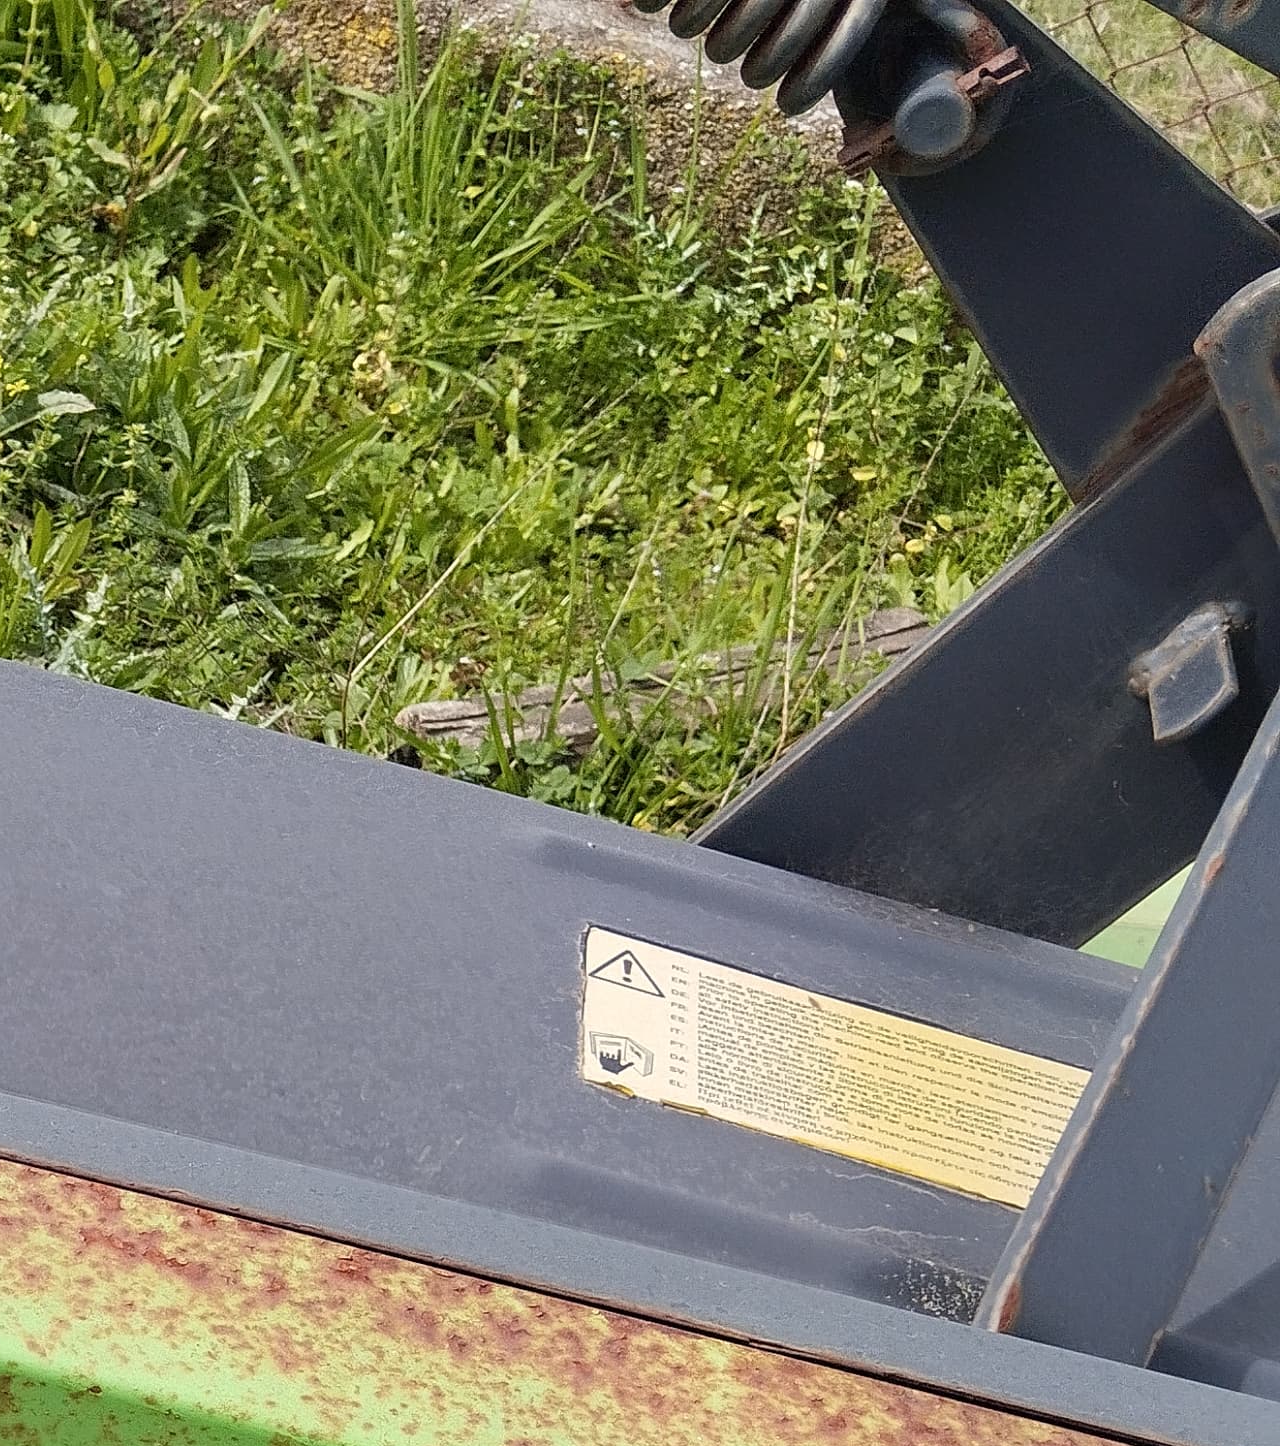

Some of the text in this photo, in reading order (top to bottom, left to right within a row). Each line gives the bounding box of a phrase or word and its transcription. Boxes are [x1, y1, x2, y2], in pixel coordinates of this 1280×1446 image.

[698, 977, 745, 997] machine
[750, 992, 760, 1001] in
[698, 990, 710, 999] all
[714, 994, 748, 1011] safety
[697, 1002, 728, 1017] lesen
[728, 980, 742, 990] de
[858, 1019, 872, 1028] en
[698, 983, 724, 997] Prior
[743, 996, 796, 1019] operating
[979, 1065, 998, 1077] the
[698, 996, 717, 1007] Vor
[813, 1030, 830, 1040] die
[939, 1066, 961, 1079] und
[966, 1074, 983, 1085] die
[768, 1035, 783, 1045] de
[697, 1034, 744, 1054] Leggere
[737, 1033, 751, 1043] de
[860, 1070, 874, 1079] en
[697, 1008, 729, 1023] Avant
[734, 1019, 743, 1028] la
[747, 1023, 775, 1037] mise
[779, 1033, 792, 1042] en
[883, 1063, 908, 1076] bien
[970, 1088, 979, 1097] le
[984, 1092, 1016, 1107] mode
[733, 1064, 747, 1074] de
[697, 1040, 717, 1052] alle
[721, 1049, 757, 1064] norme
[762, 1059, 772, 1068] di
[934, 1110, 944, 1119] in
[697, 1073, 730, 1088] Innan
[743, 1041, 757, 1051] de
[819, 1063, 834, 1074] las
[922, 1094, 936, 1104] de
[765, 1067, 780, 1077] de
